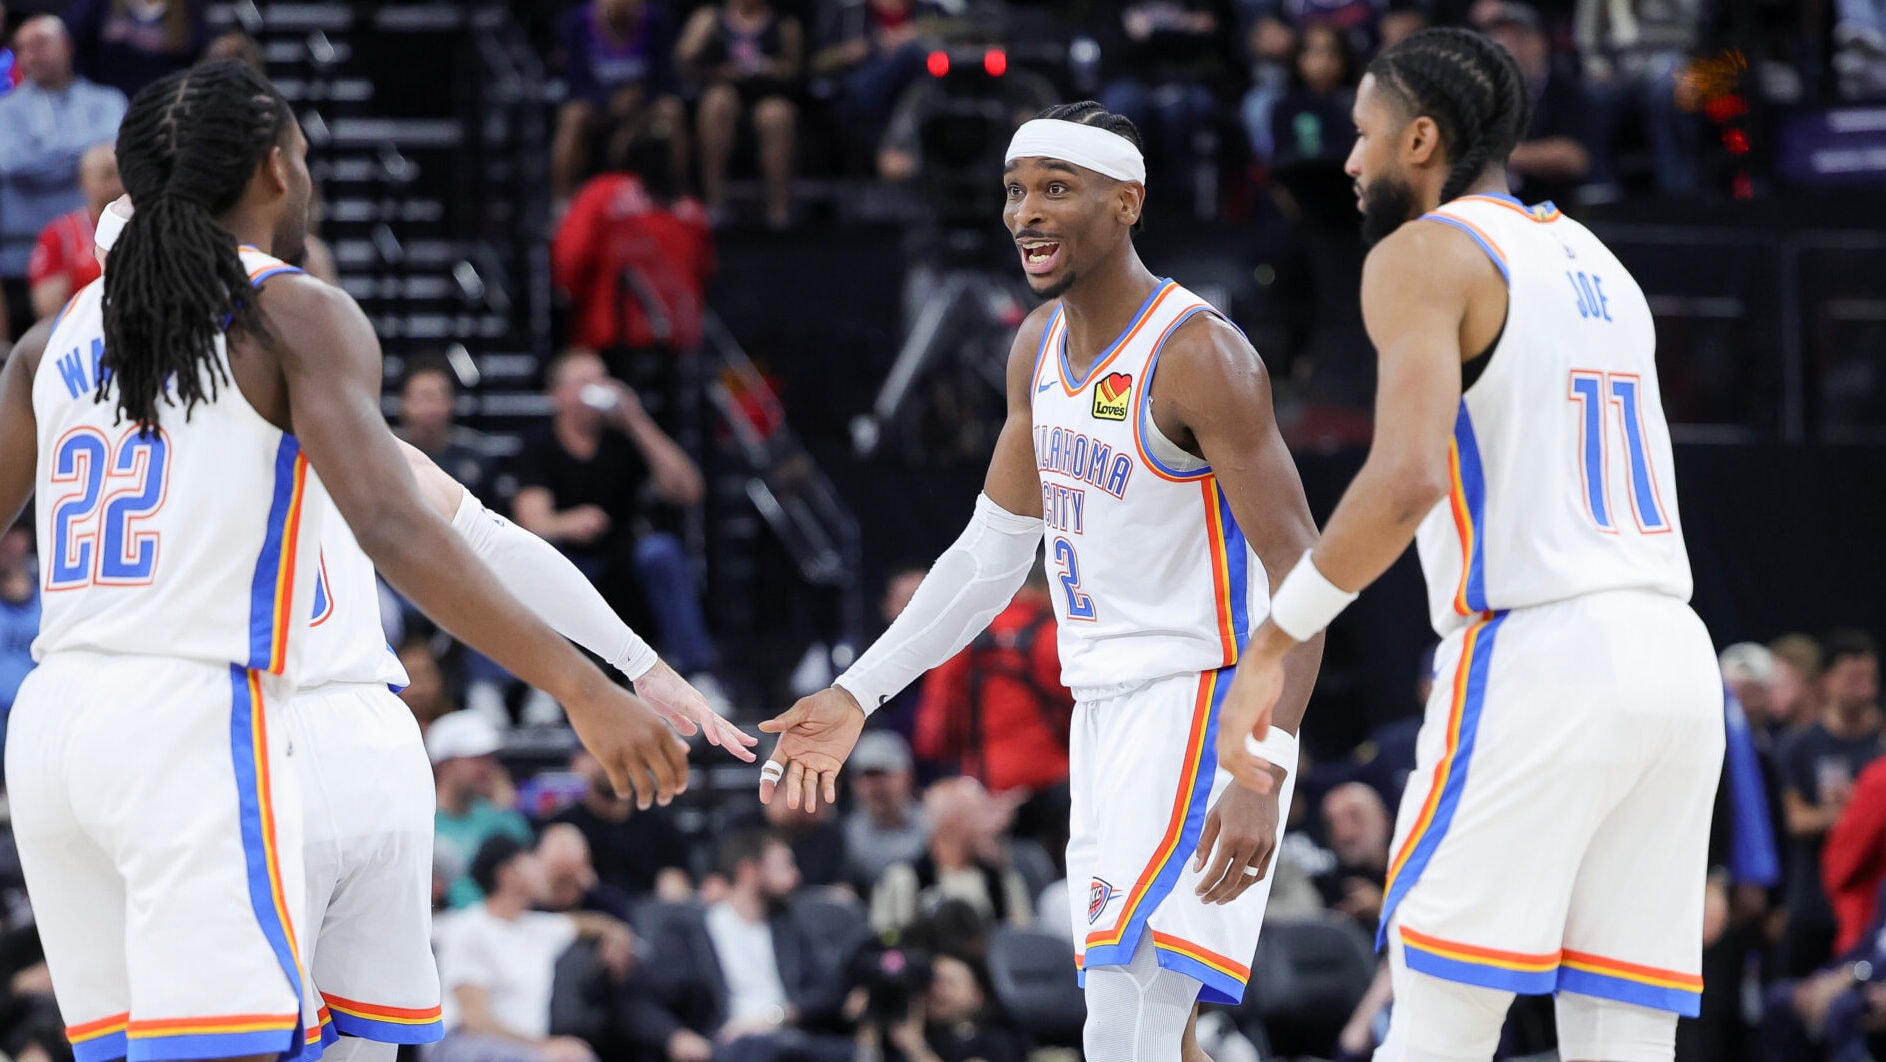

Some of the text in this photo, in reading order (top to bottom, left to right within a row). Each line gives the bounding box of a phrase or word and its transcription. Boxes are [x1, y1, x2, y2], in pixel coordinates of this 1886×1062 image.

[1566, 270, 1613, 322] JOE
[1034, 424, 1133, 500] LAHOMA
[1568, 369, 1672, 535] 11
[45, 424, 172, 592] 22
[1042, 480, 1085, 535] CITY
[1053, 535, 1098, 623] 2
